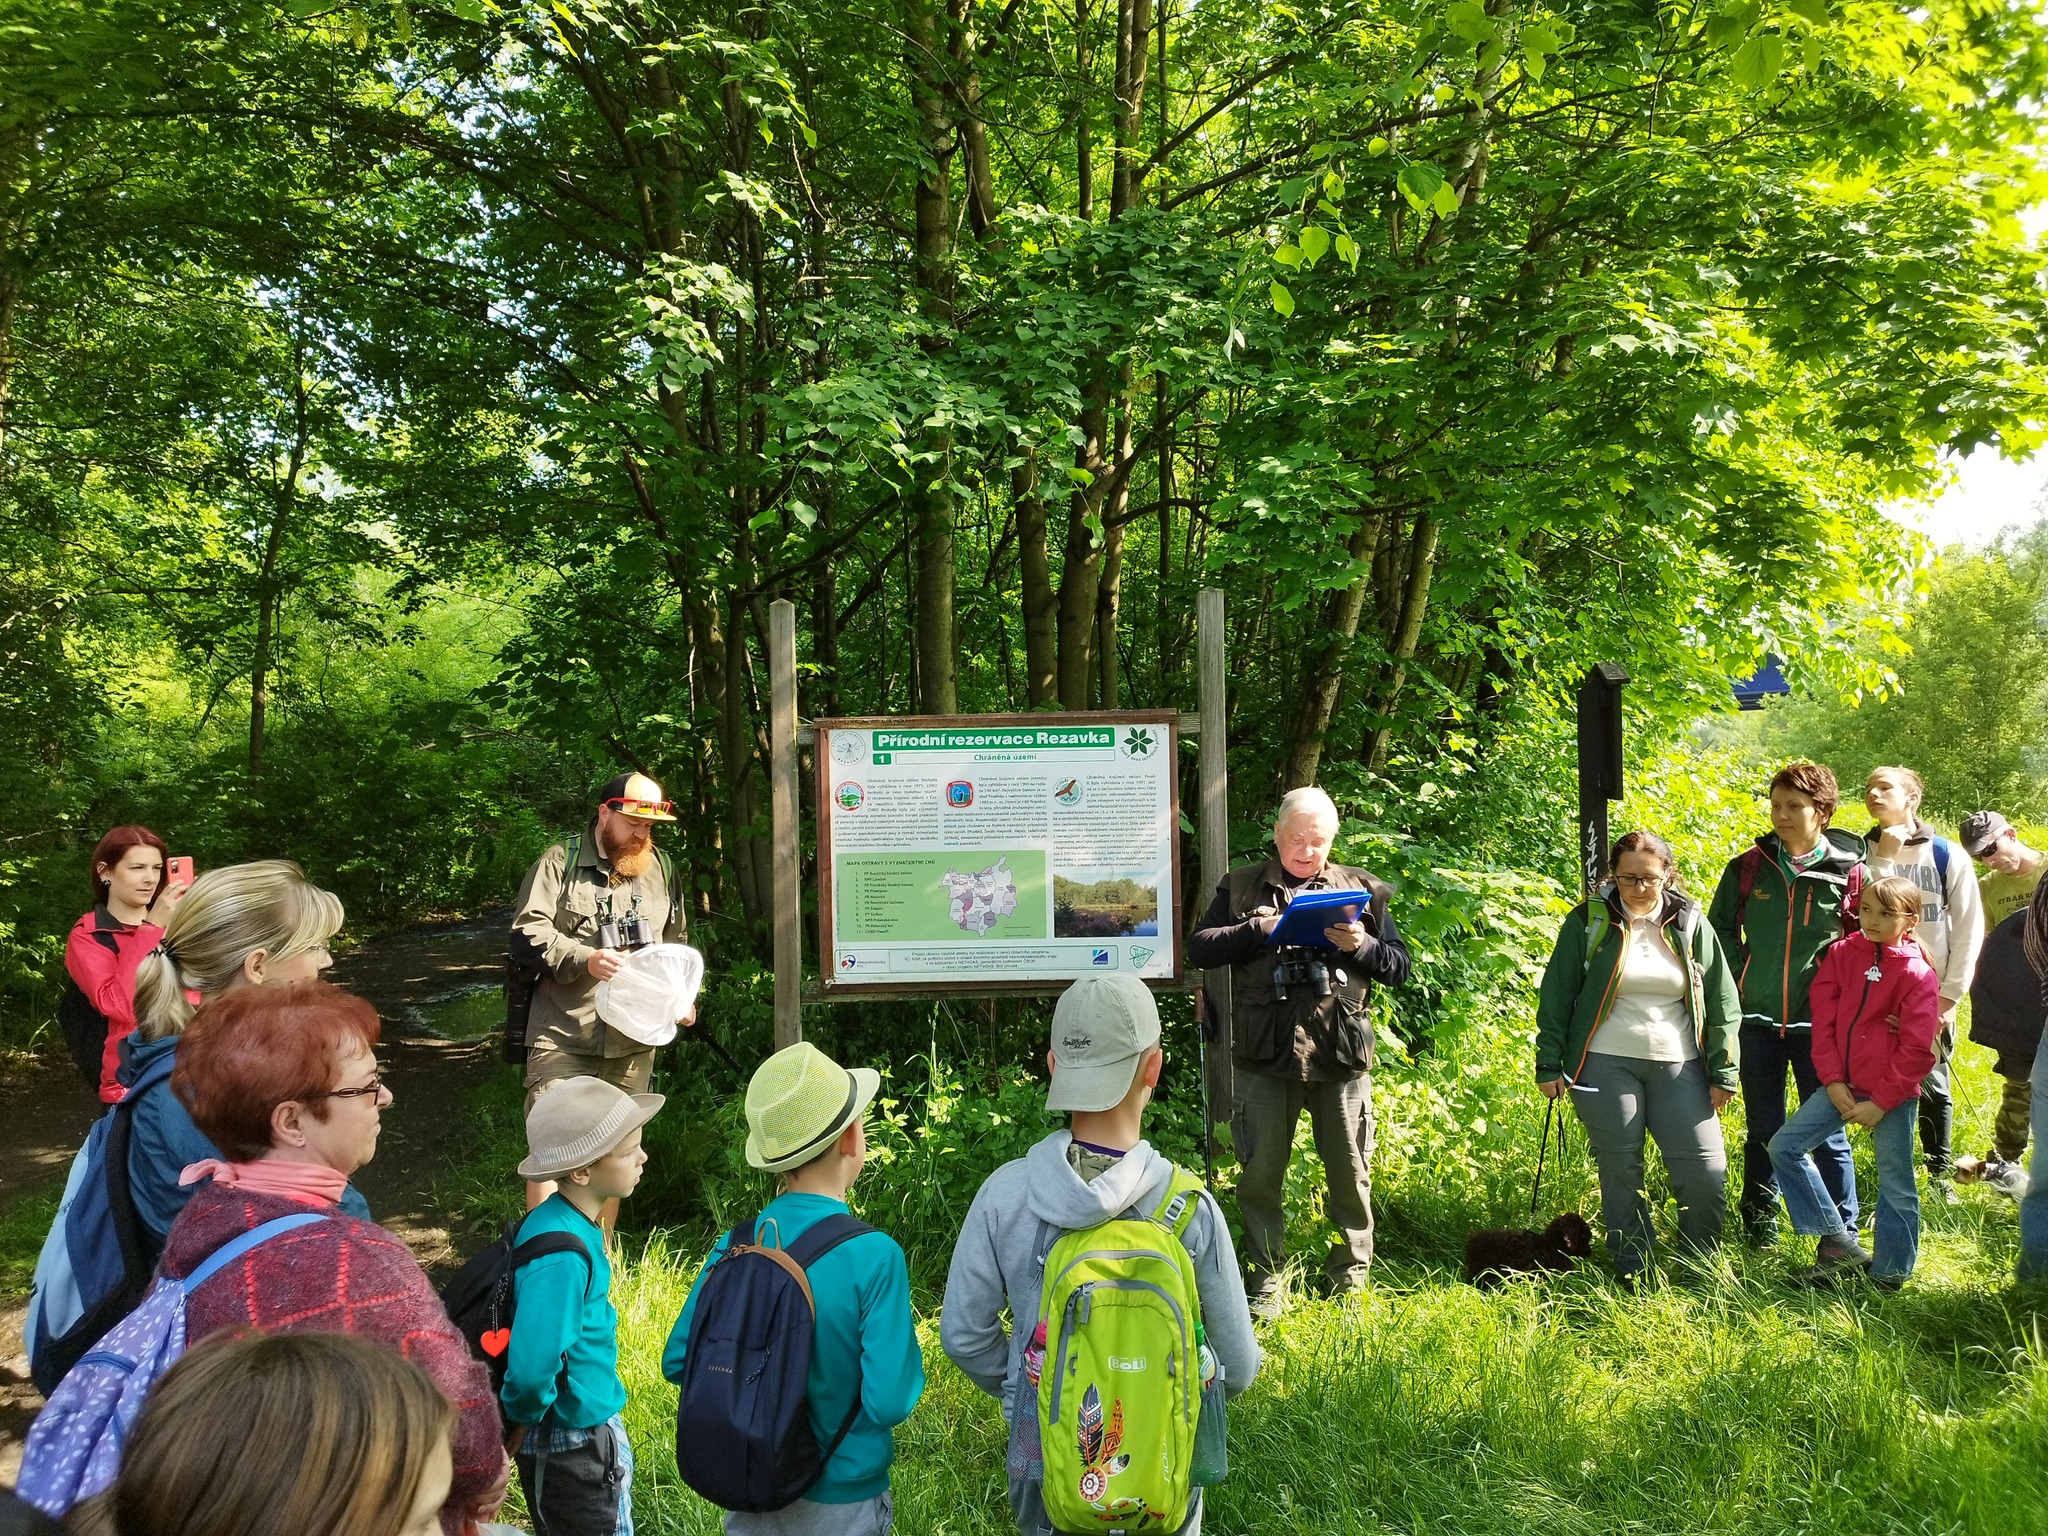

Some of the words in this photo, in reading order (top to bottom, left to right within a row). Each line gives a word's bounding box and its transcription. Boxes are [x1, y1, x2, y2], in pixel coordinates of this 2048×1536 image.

[878, 734, 946, 747] Přírodní
[948, 735, 1034, 746] rezervace
[1036, 732, 1110, 744] Rezavka
[879, 755, 885, 764] 1
[974, 754, 1010, 762] Chráněná
